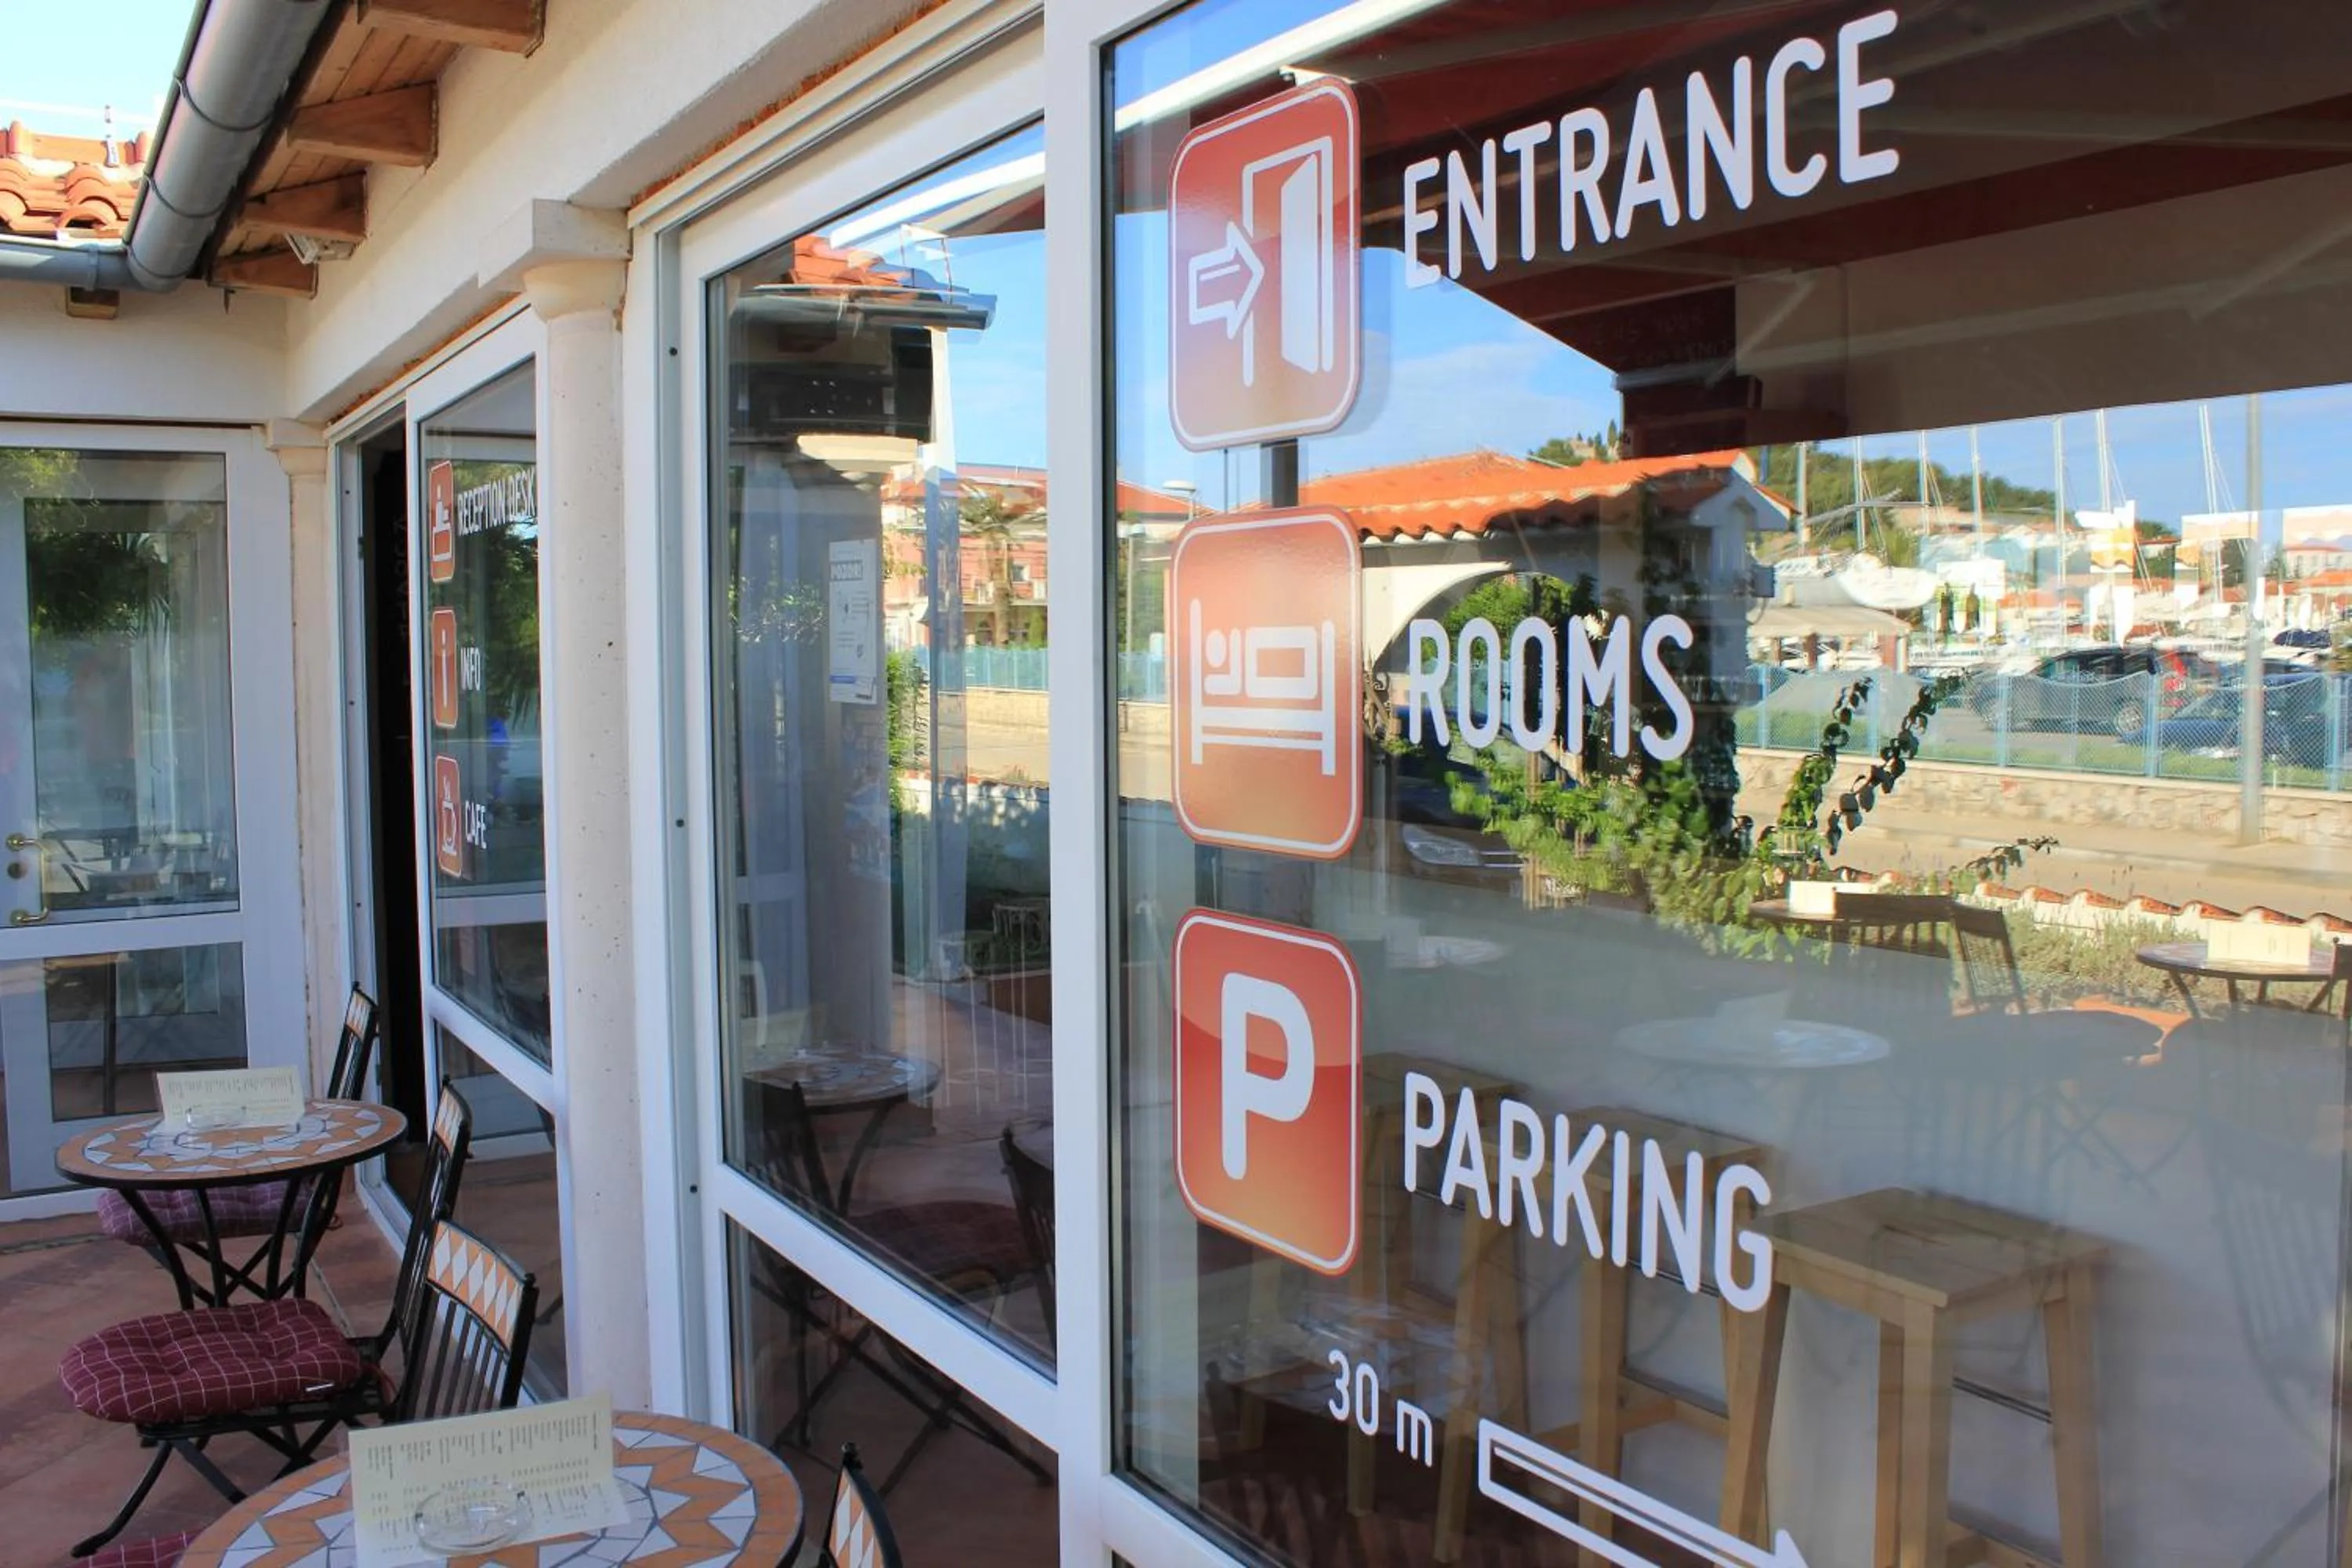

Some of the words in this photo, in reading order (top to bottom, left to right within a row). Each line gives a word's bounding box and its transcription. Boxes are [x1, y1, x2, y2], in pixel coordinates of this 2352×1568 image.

[1403, 9, 1900, 289] ENTRANCE
[458, 477, 506, 536] RECEPTION
[508, 467, 535, 522] DESK
[460, 647, 481, 691] INFO
[1409, 614, 1694, 760] ROOMS
[465, 800, 487, 849] CAFE
[1221, 972, 1315, 1180] P
[1404, 1072, 1773, 1312] PARKING
[1328, 1349, 1379, 1436] 30
[1396, 1399, 1433, 1468] m
